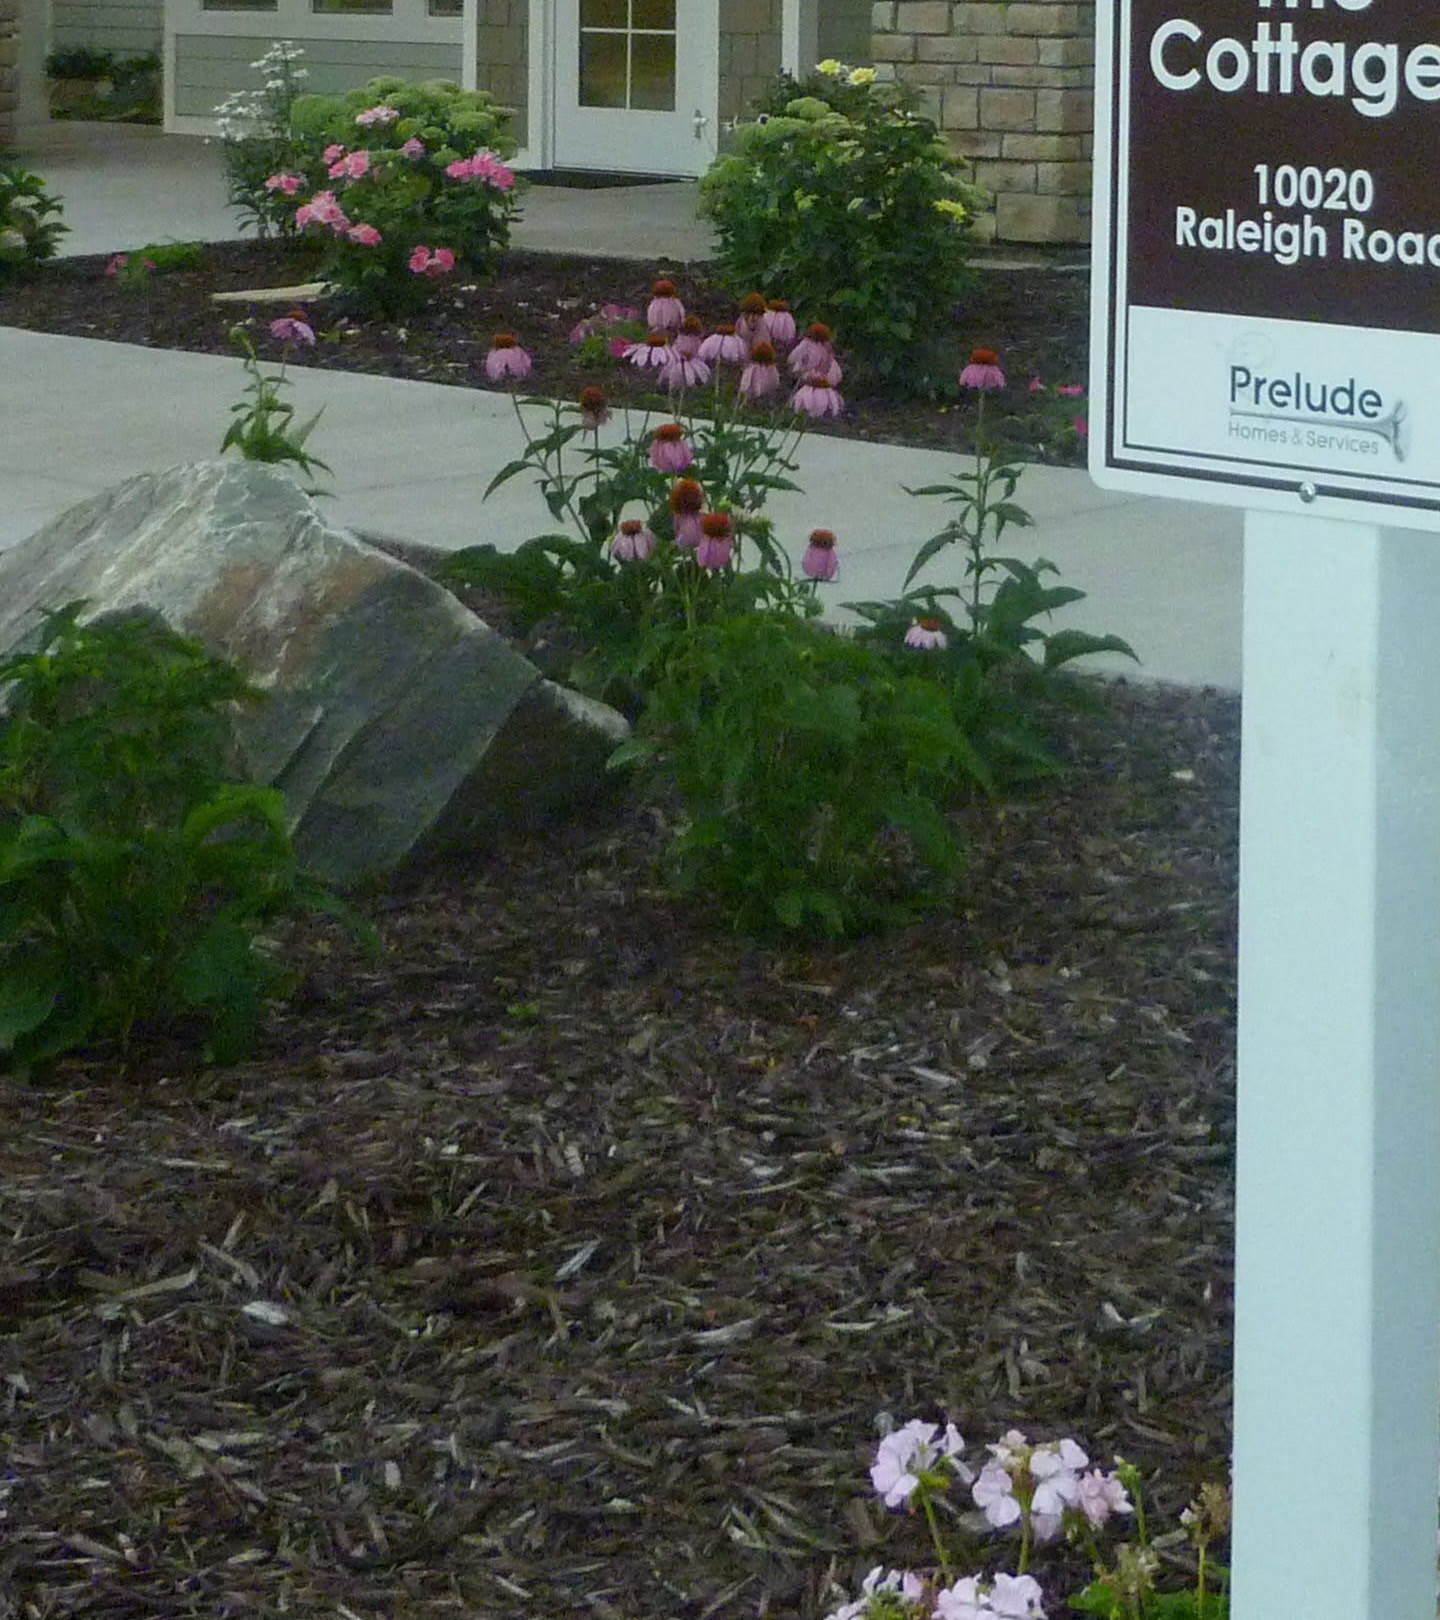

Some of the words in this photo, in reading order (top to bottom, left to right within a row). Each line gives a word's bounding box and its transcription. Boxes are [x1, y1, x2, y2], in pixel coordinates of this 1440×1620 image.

[1253, 163, 1374, 212] 10020
[1175, 206, 1328, 266] Raleigh
[1230, 365, 1383, 419] Prelude
[1227, 421, 1288, 445] Homes
[1290, 428, 1304, 446] &
[1306, 429, 1380, 456] Services
